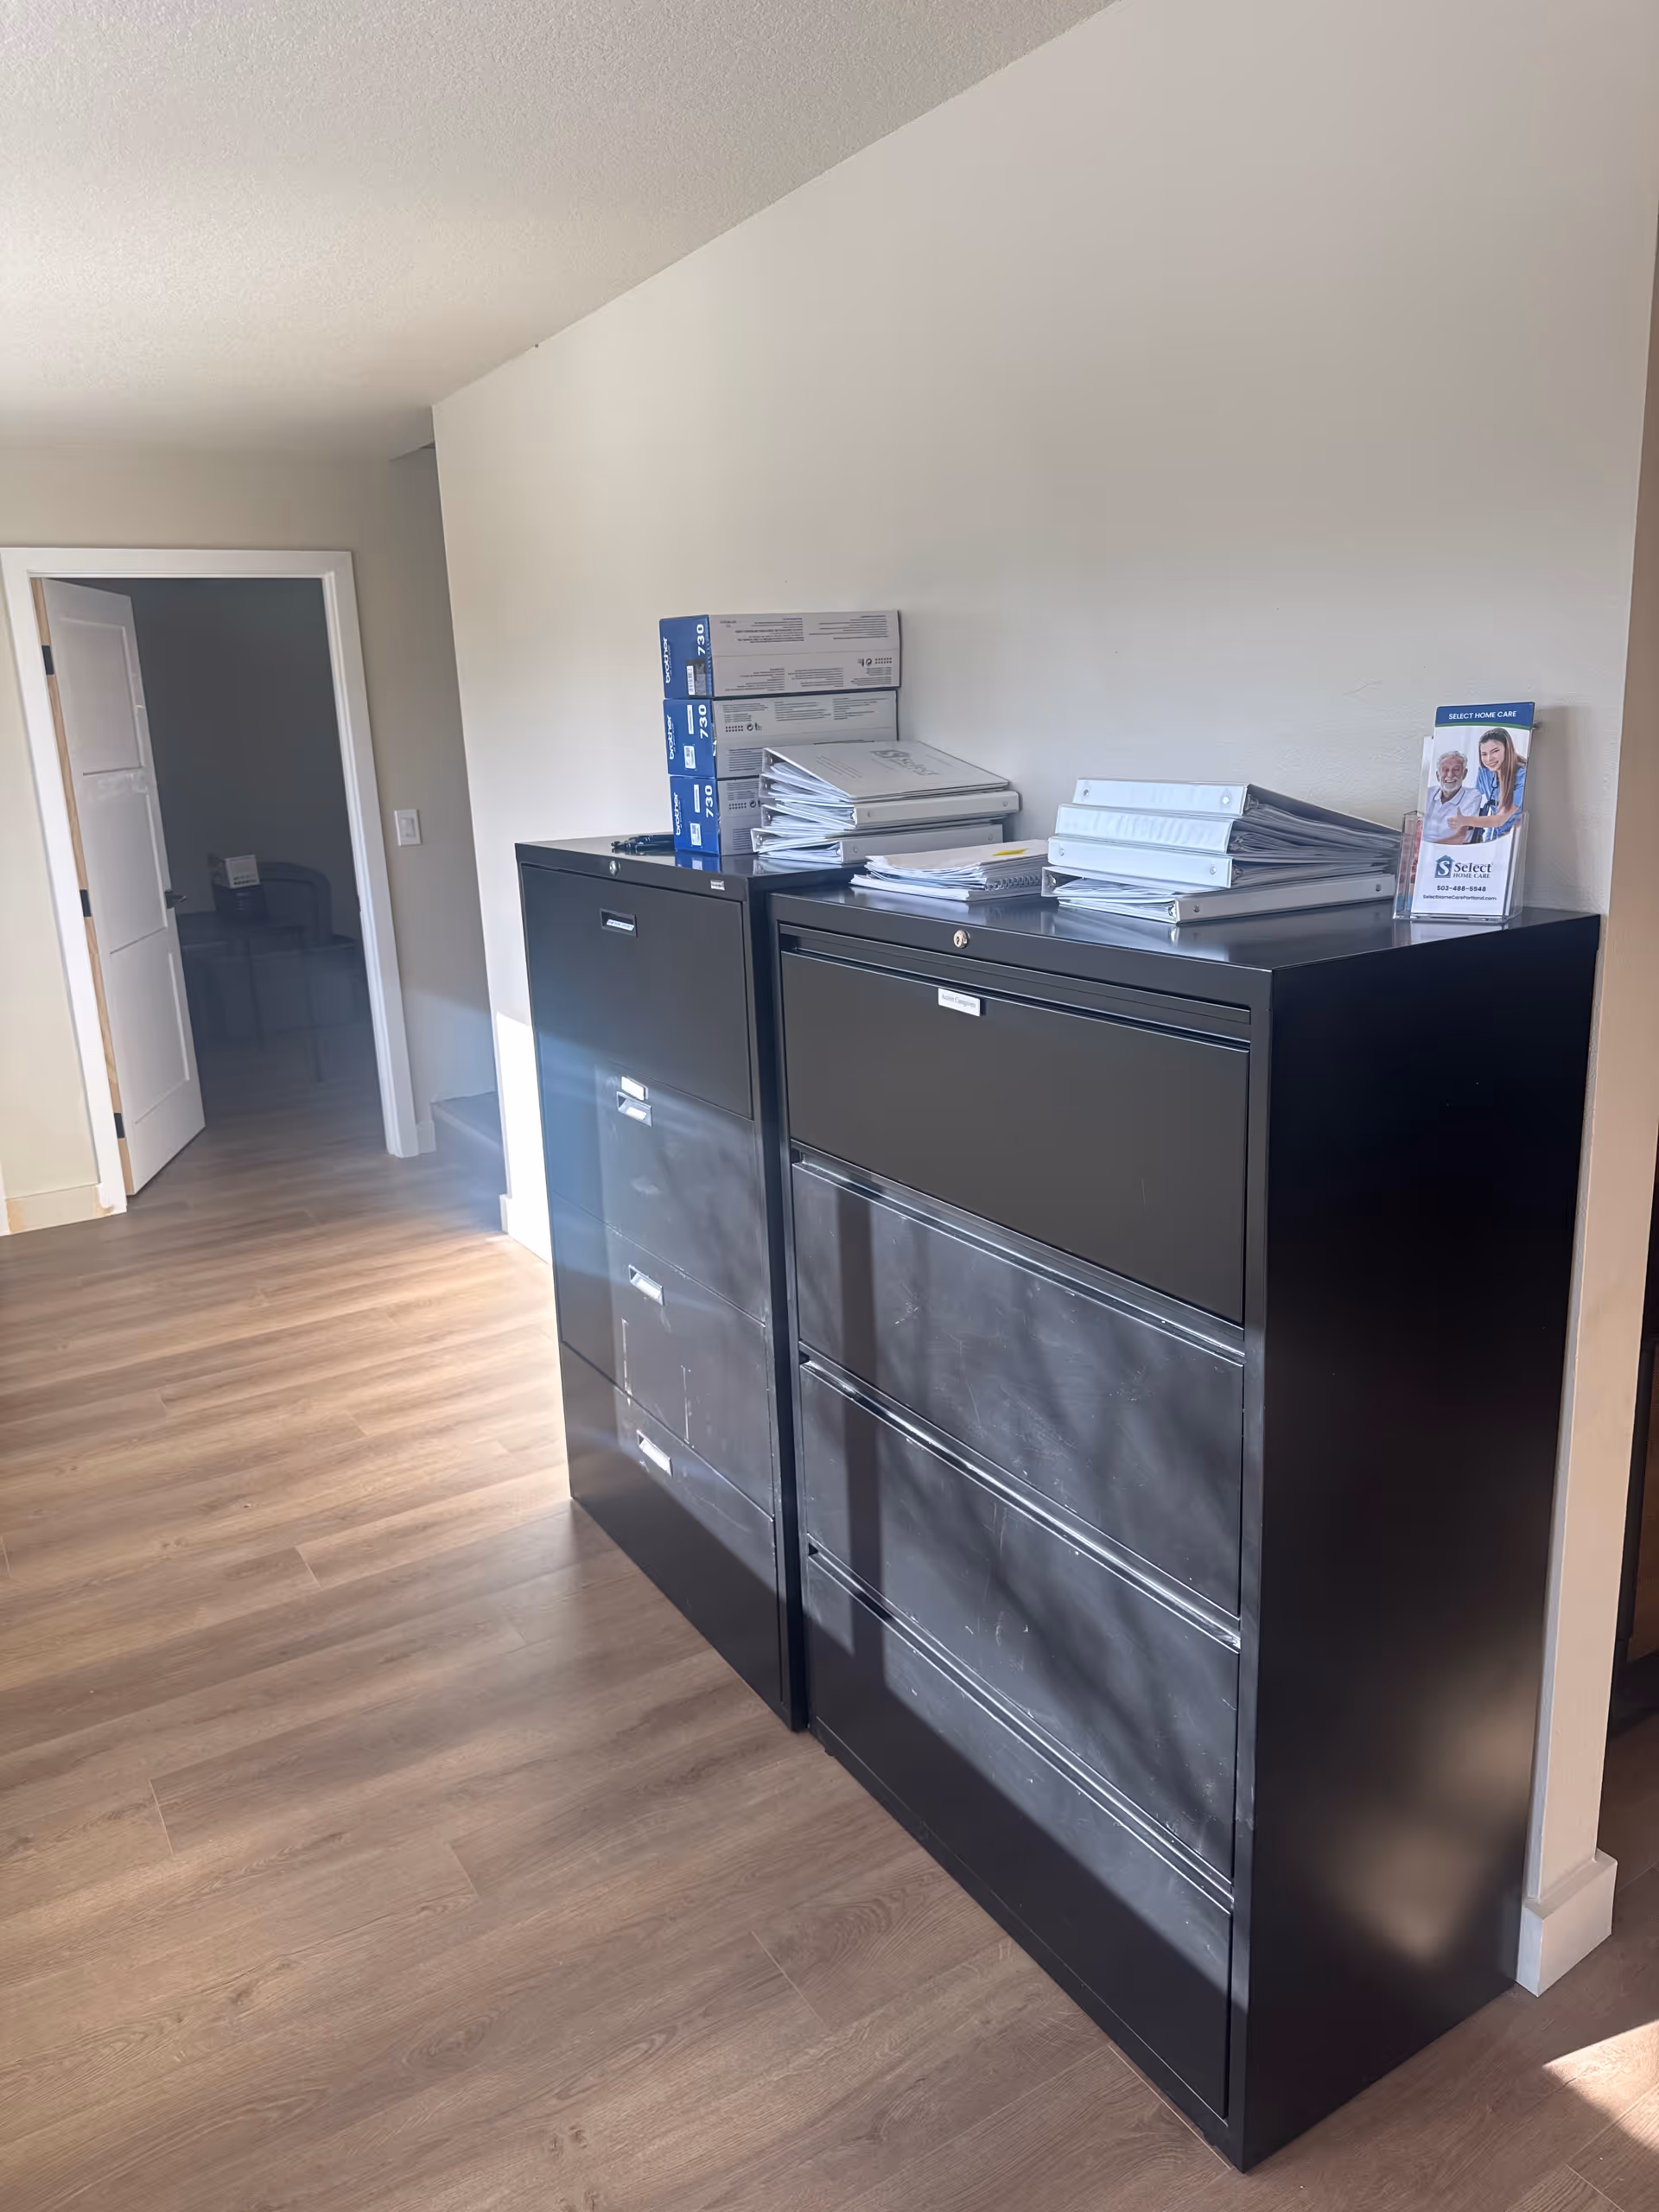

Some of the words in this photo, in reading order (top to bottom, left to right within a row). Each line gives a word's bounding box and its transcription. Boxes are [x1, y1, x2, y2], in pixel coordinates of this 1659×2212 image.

[696, 624, 706, 656] 730
[666, 715, 675, 760] brother
[698, 704, 709, 739] 730
[704, 785, 715, 817] 730
[1437, 860, 1450, 876] S
[1453, 862, 1492, 873] Select
